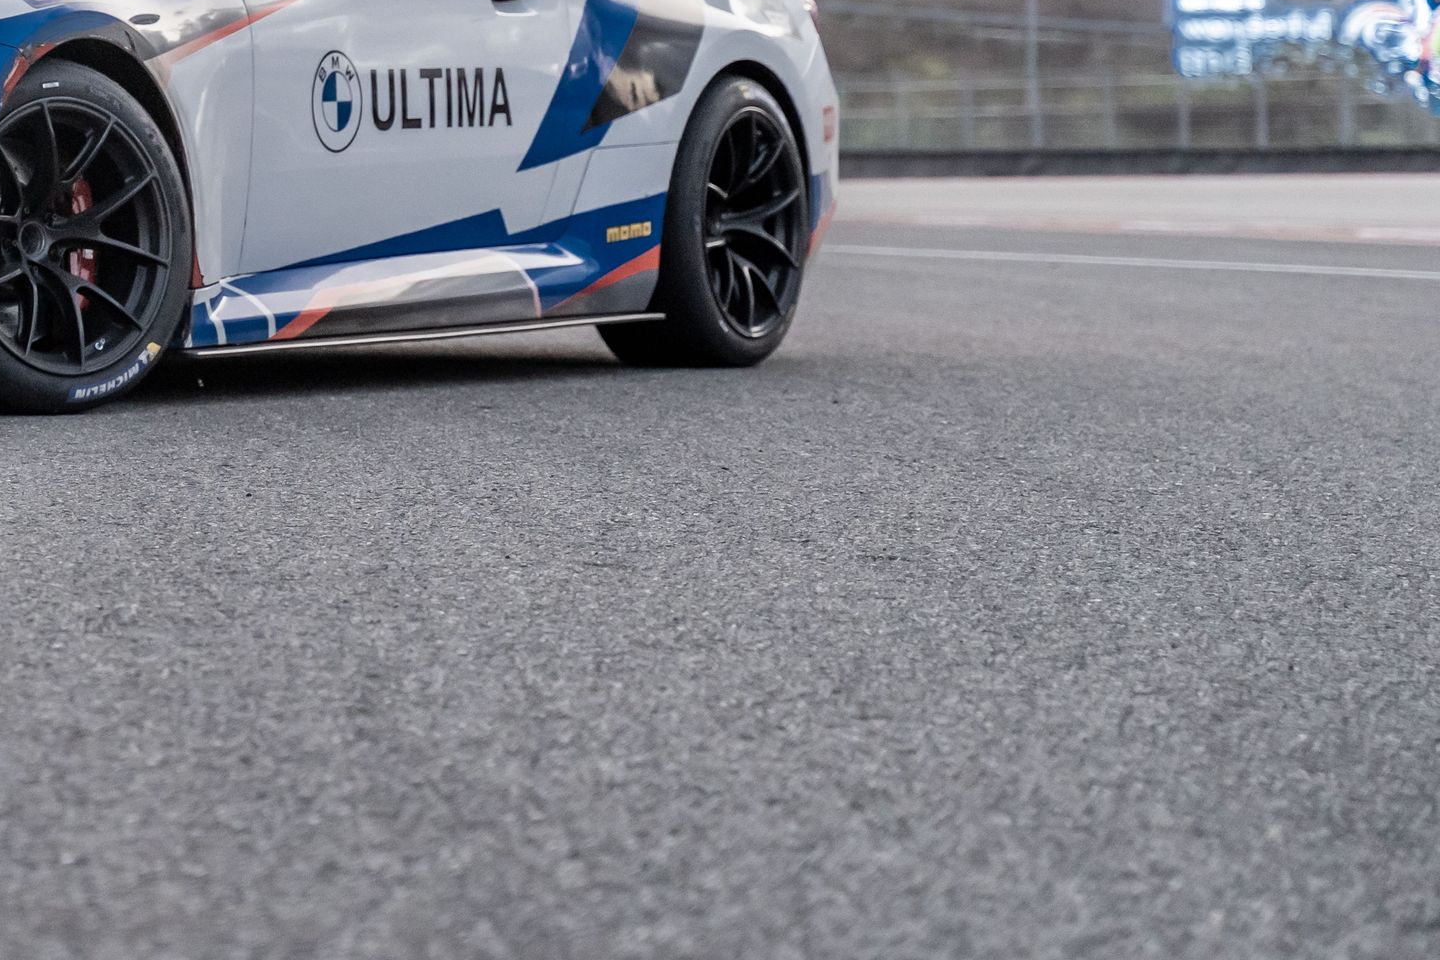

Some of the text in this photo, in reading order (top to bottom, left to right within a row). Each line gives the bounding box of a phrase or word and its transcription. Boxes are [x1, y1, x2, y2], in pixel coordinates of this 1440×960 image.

[370, 67, 513, 132] ULTIMA
[606, 221, 652, 244] momo
[74, 362, 140, 399] MICHELIN
